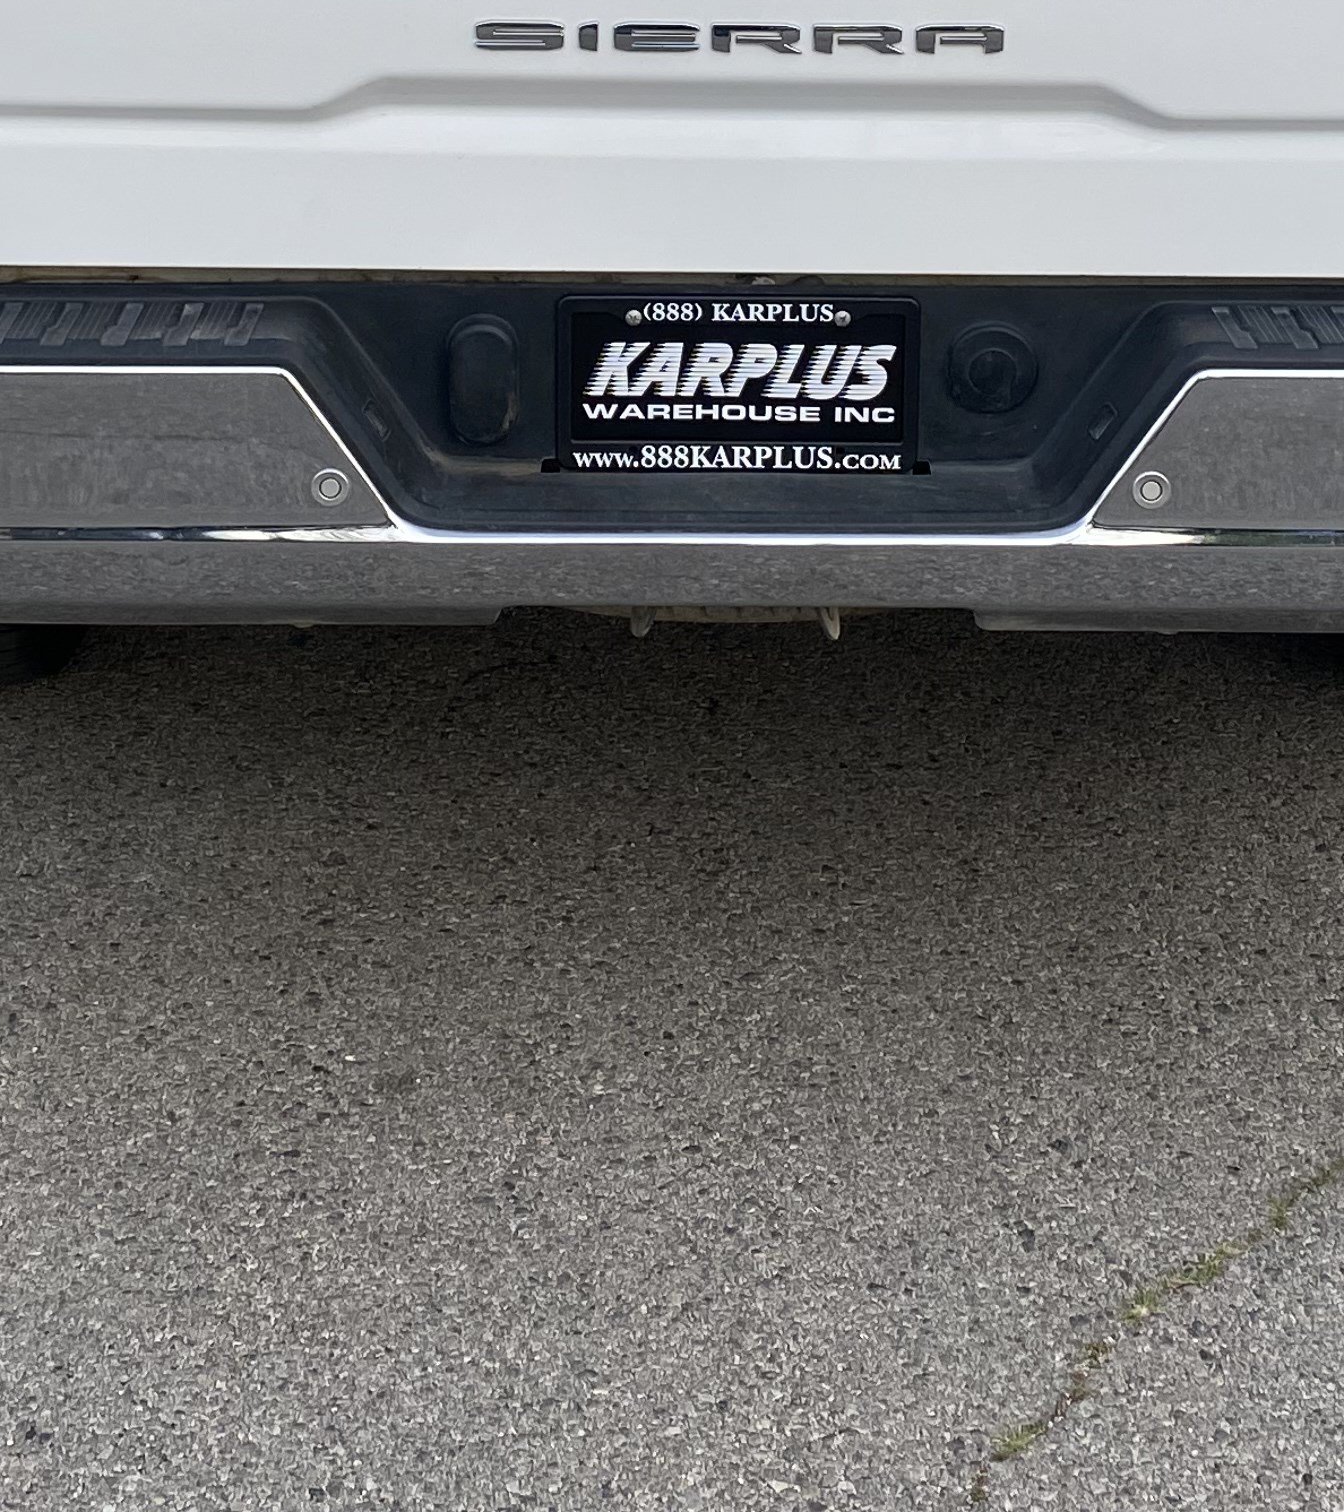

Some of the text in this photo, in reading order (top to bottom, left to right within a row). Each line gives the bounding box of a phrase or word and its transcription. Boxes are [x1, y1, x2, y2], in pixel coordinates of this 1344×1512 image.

[474, 20, 1005, 55] SIERRA
[643, 302, 834, 323] (888) KARPLUS
[582, 341, 898, 402] KARPLUS
[582, 402, 896, 423] WAREHOUSE INC
